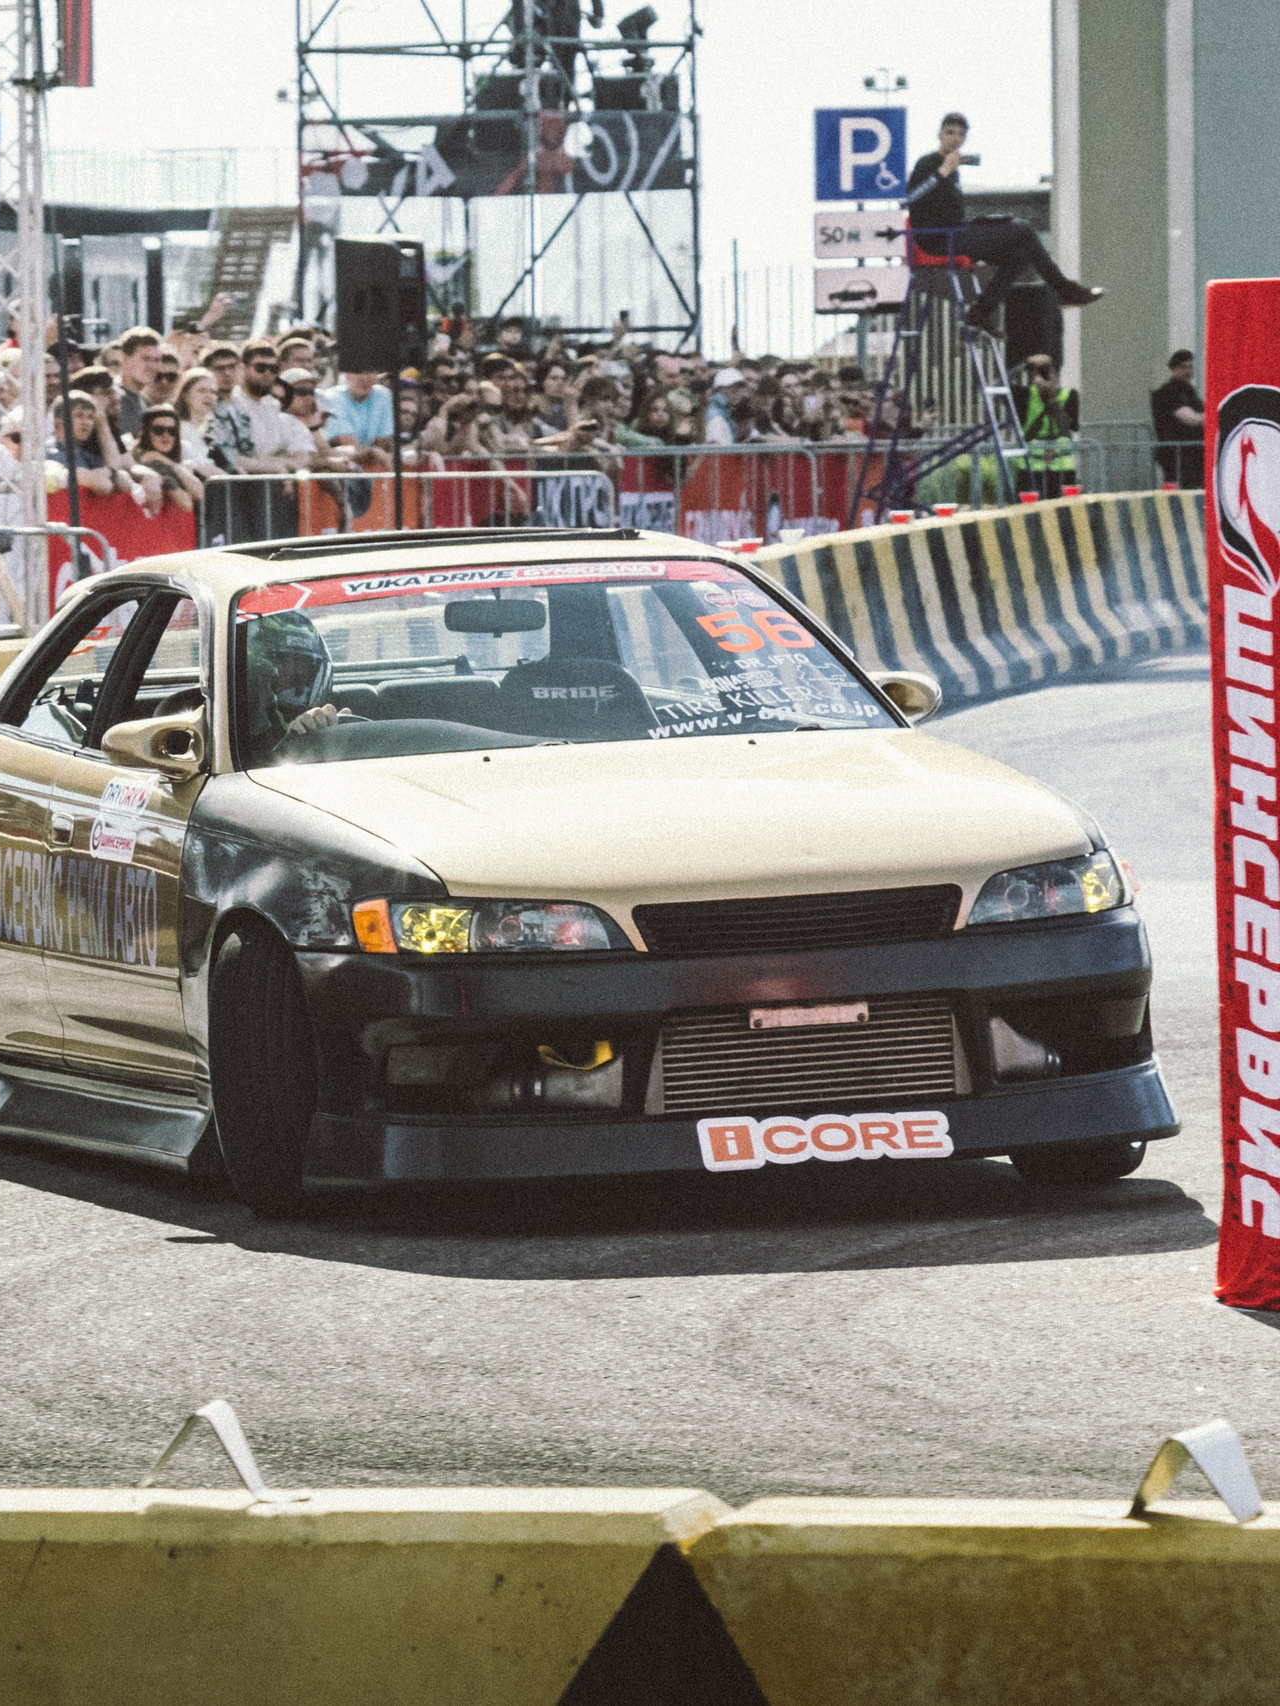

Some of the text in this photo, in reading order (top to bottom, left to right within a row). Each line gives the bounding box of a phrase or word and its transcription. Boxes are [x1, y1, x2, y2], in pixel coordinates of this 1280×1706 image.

[839, 117, 891, 191] P
[820, 227, 844, 245] 50
[349, 564, 654, 592] YUKA DRIVE GYMKHANA
[695, 610, 816, 653] 56
[531, 685, 616, 701] BRIDE
[656, 684, 822, 720] TIRE KILLER
[114, 867, 158, 968] АВТО
